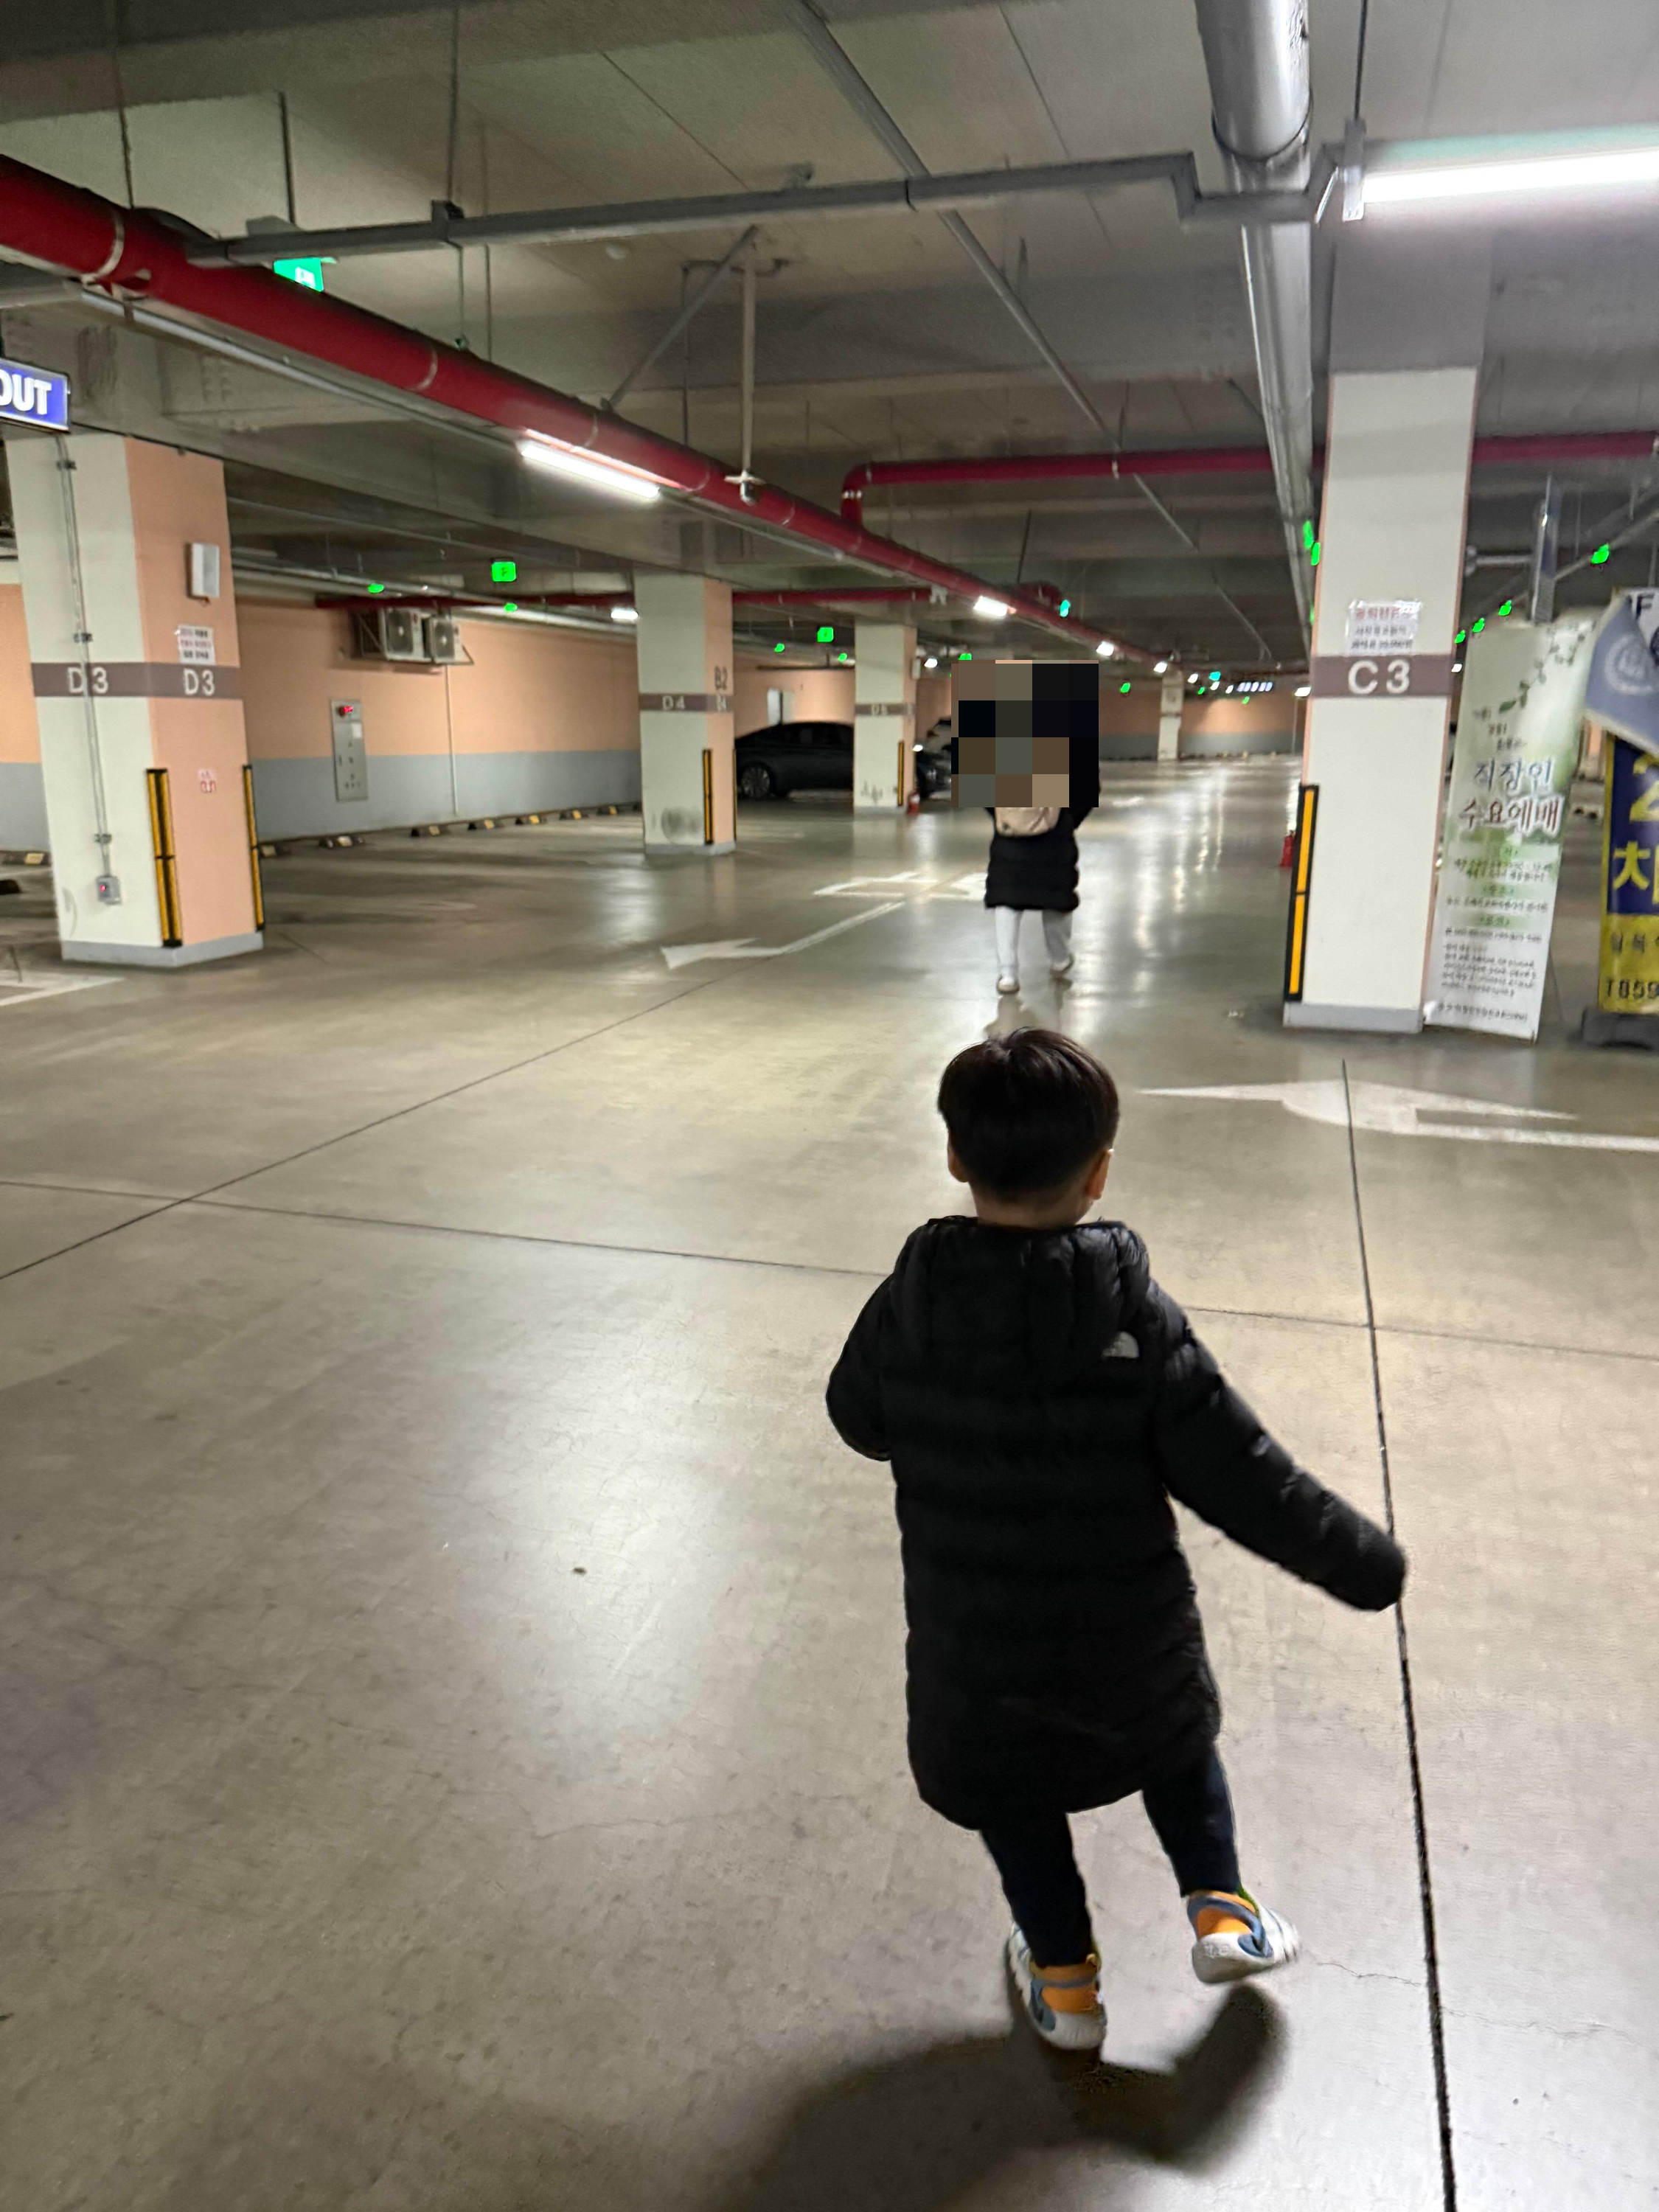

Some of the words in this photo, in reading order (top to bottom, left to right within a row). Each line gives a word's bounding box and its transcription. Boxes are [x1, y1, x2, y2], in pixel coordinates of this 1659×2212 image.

[0, 369, 52, 415] OUT
[66, 666, 109, 695] D3
[184, 667, 215, 696] D3
[1348, 658, 1411, 695] C3
[662, 695, 685, 710] D4
[1458, 796, 1560, 833] 수요예배
